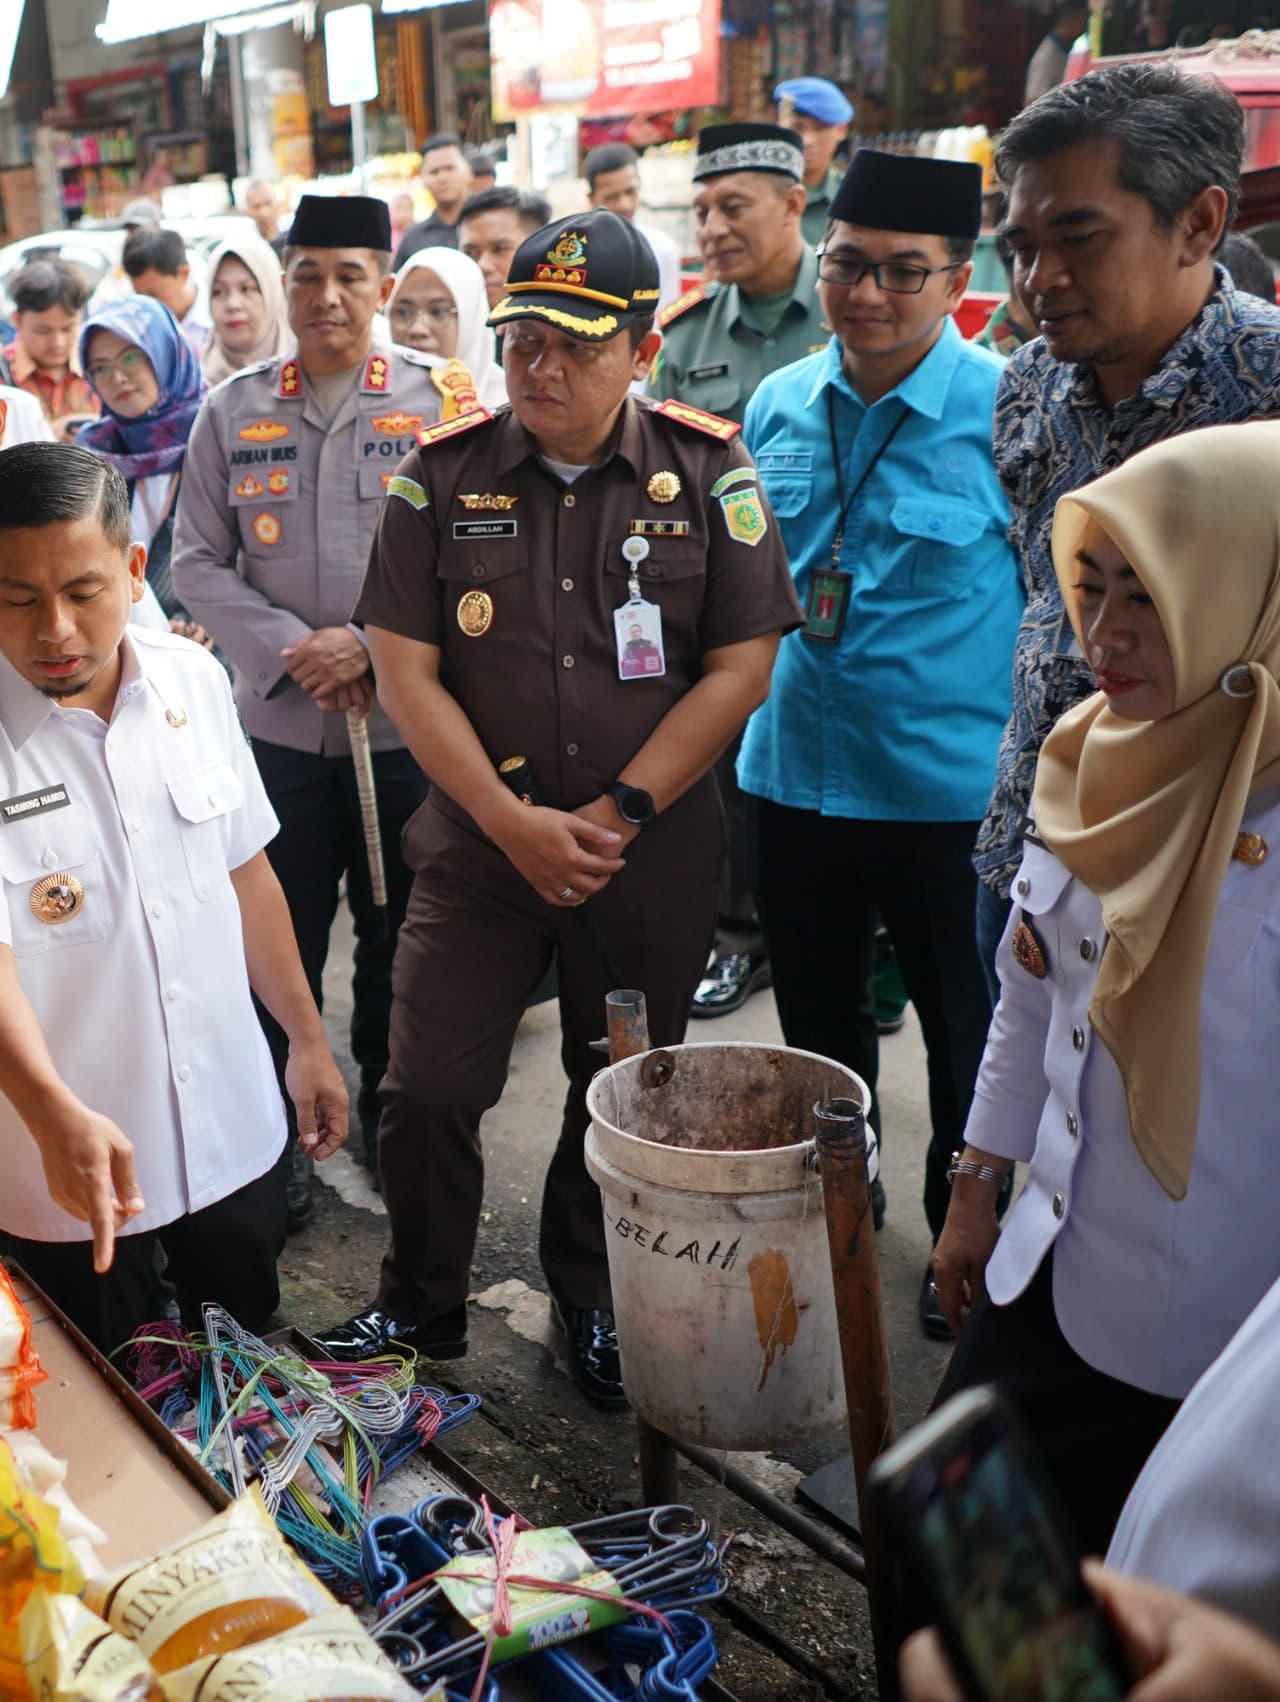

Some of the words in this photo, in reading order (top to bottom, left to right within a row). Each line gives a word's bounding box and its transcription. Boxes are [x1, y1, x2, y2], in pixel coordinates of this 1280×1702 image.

[230, 449, 268, 466] ARMAN
[271, 446, 297, 461] MUIS
[467, 525, 503, 534] ABDILLAH
[39, 791, 66, 806] HAMID
[614, 1216, 741, 1272] BELAH
